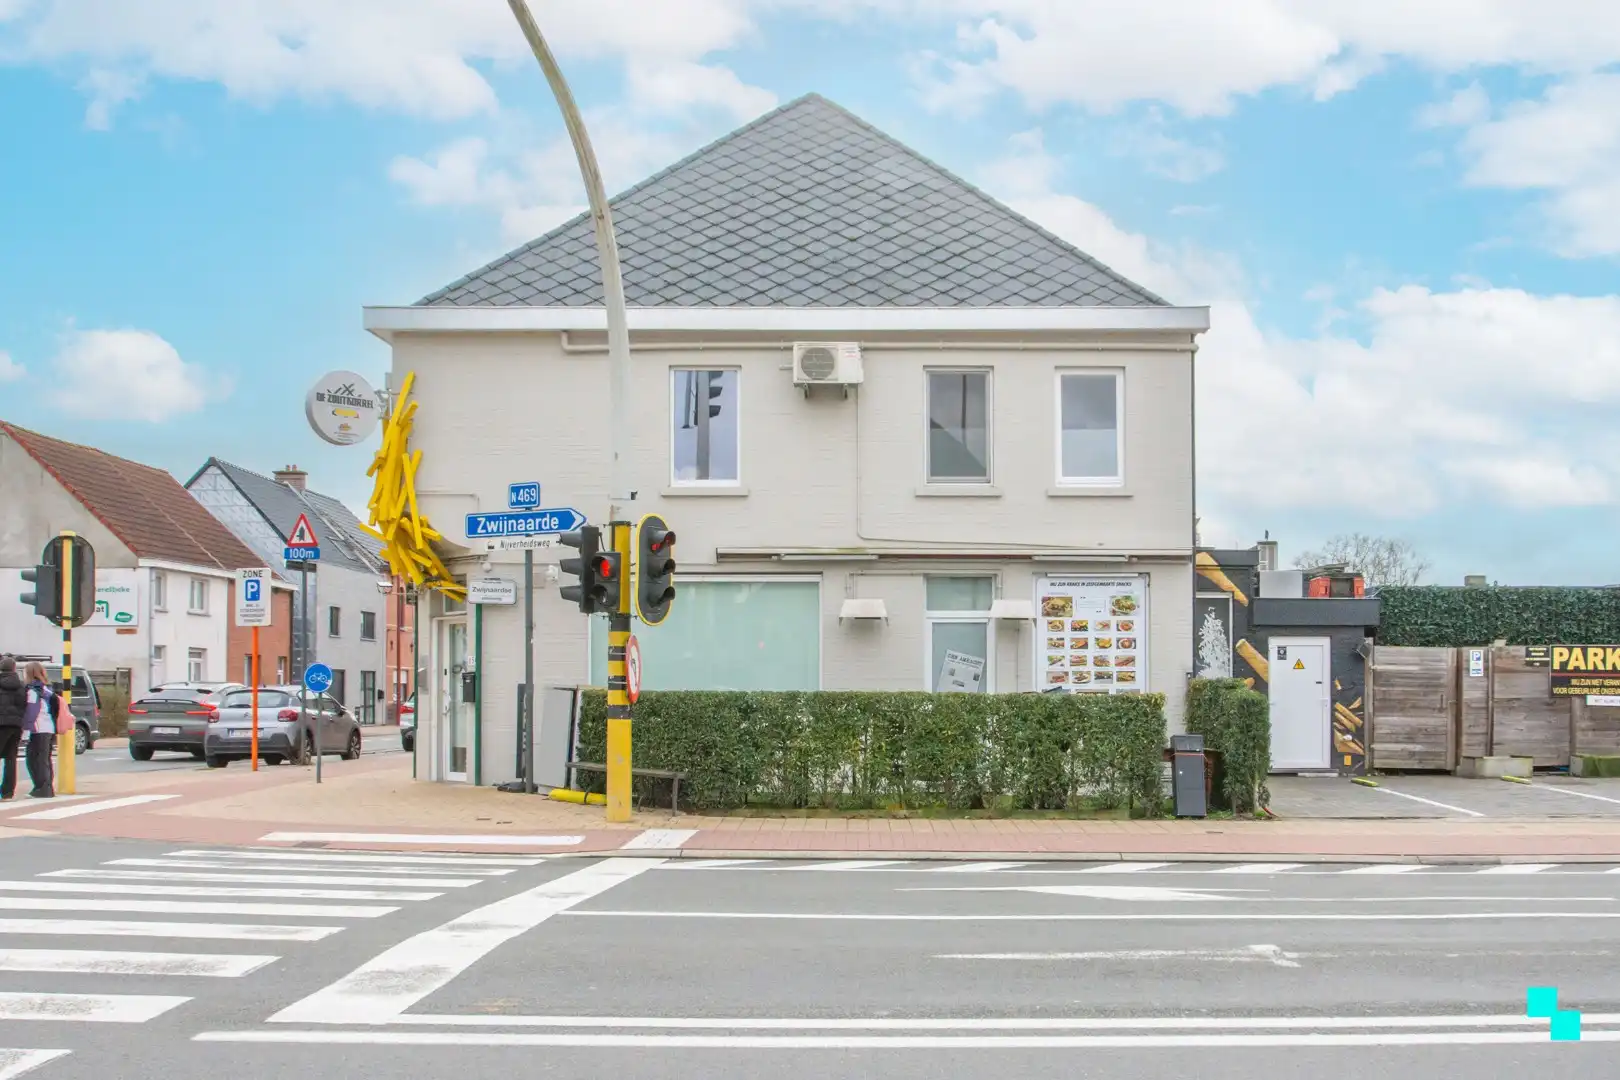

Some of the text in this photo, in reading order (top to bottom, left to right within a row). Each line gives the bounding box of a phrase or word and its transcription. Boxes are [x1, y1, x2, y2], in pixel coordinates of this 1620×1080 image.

[511, 487, 537, 503] N 469
[476, 513, 559, 536] Zwijnaarde
[499, 539, 551, 551] Nijverheidsweg
[290, 548, 314, 559] 100m
[242, 570, 263, 578] ZONE
[247, 582, 258, 599] P
